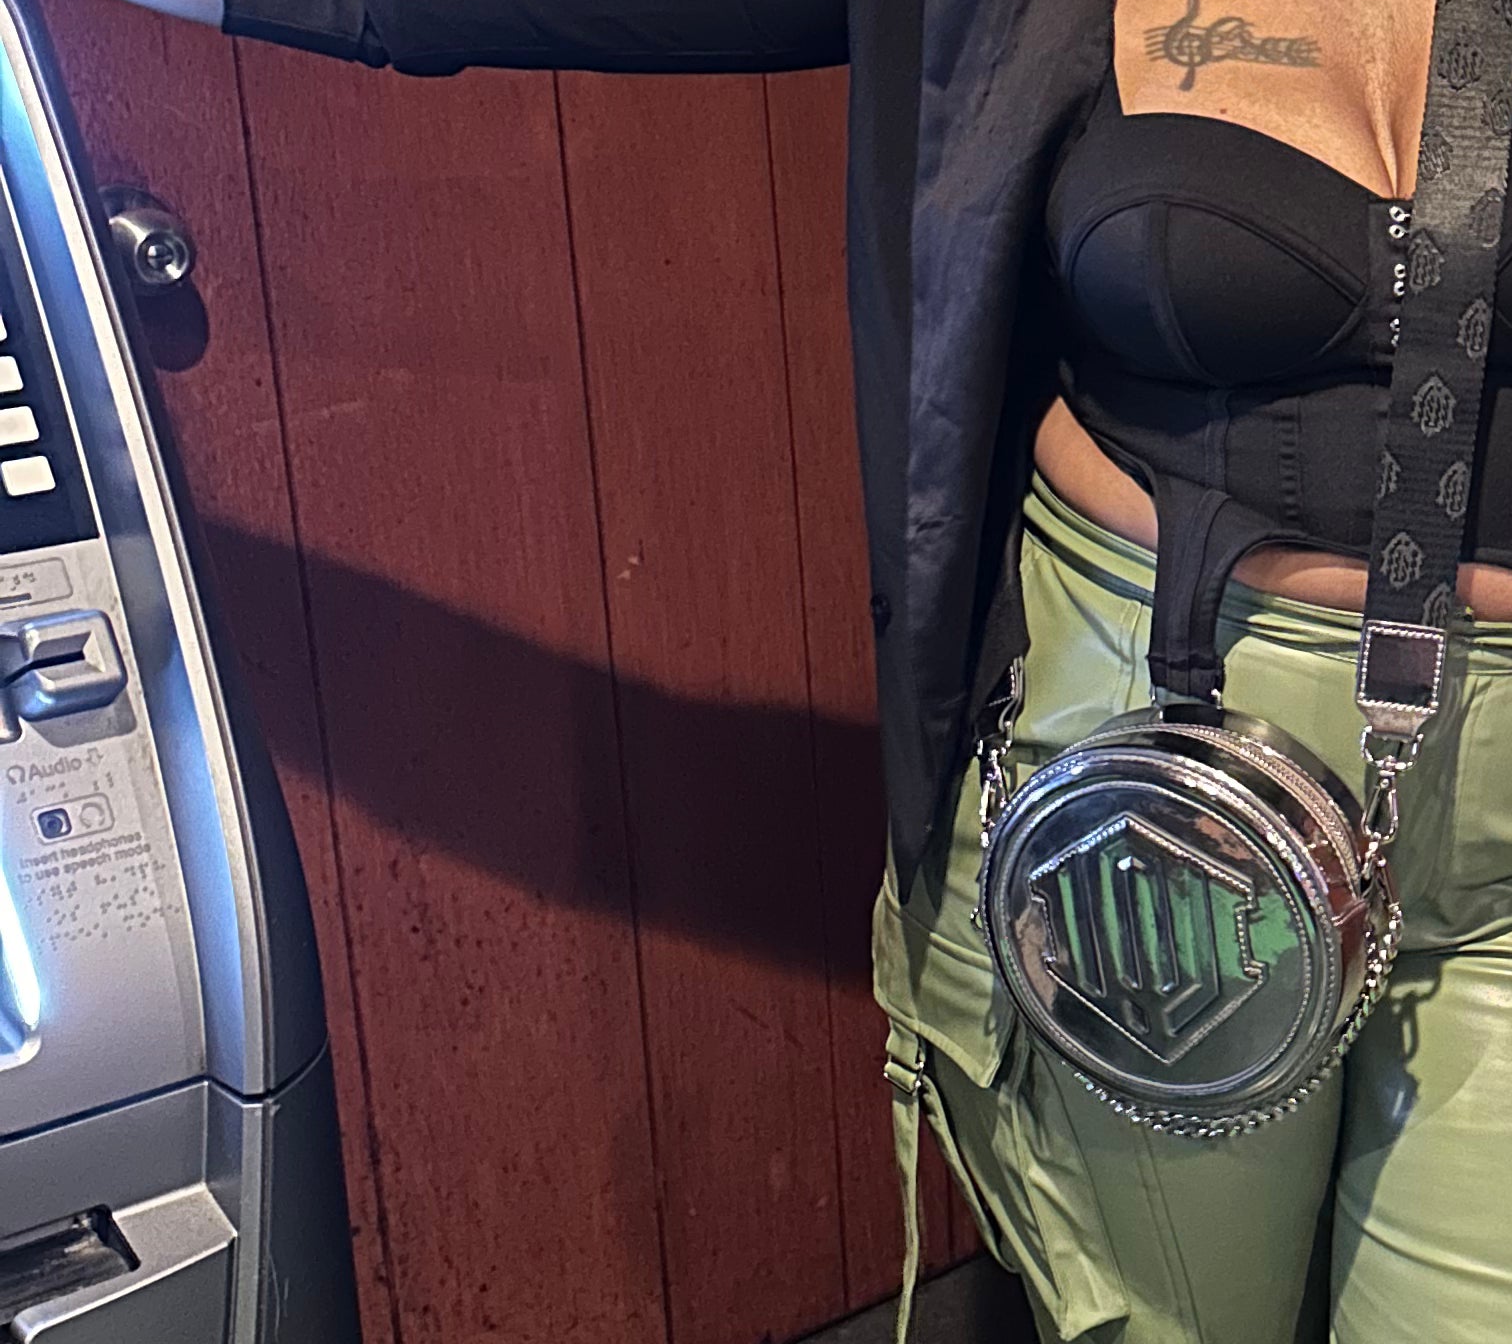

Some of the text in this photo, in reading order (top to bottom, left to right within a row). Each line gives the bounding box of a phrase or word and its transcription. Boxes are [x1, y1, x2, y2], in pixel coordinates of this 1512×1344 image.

[29, 756, 83, 781] Audio
[17, 842, 151, 885] to use speech mode
[19, 831, 142, 868] Insert headphones
